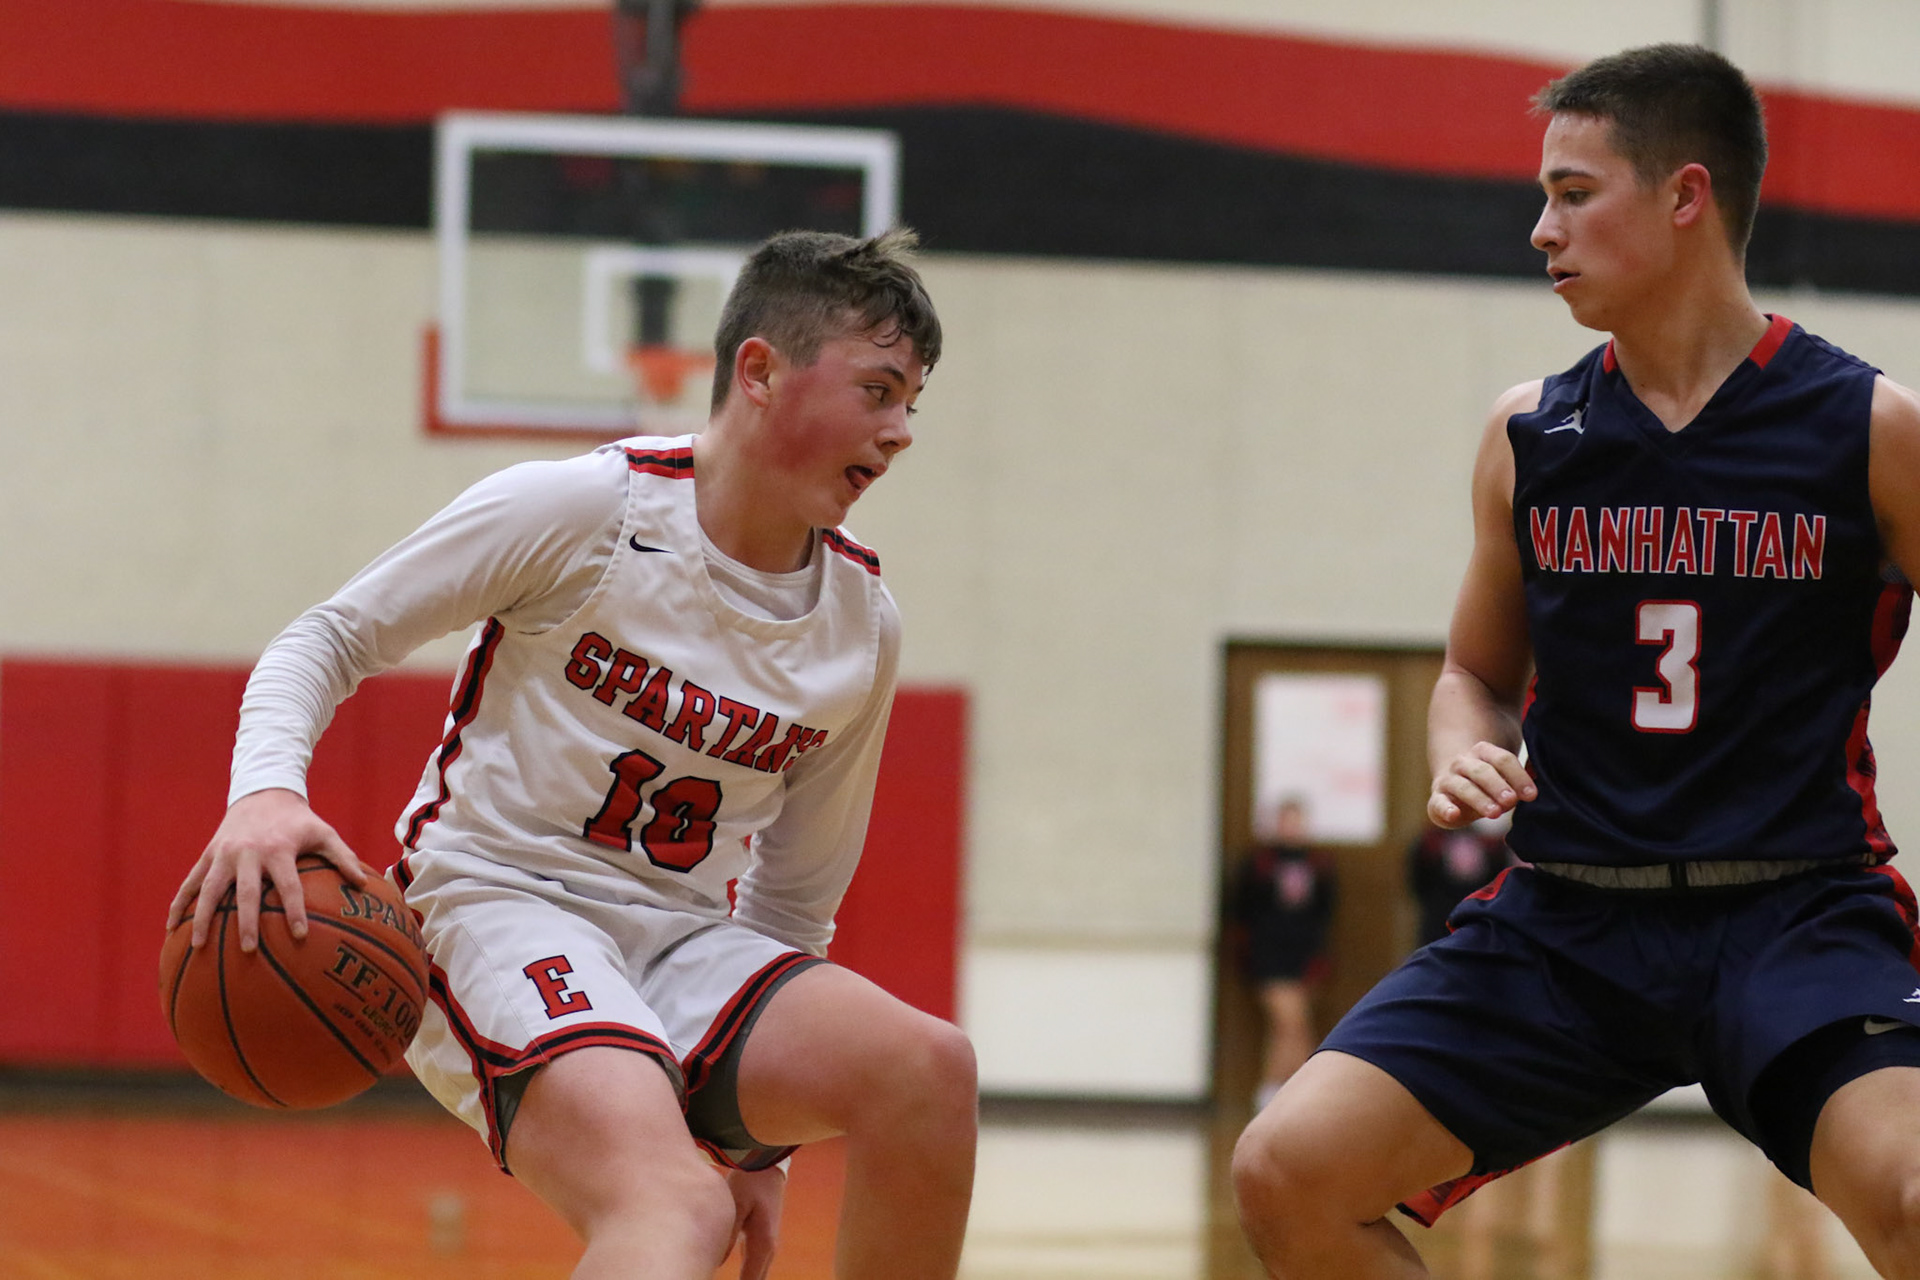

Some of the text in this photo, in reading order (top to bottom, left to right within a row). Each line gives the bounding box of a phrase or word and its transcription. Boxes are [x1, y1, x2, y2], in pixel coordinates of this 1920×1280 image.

[1530, 506, 1827, 580] MANHATTAN
[1631, 599, 1702, 735] 3
[582, 748, 723, 874] 10
[522, 954, 594, 1020] E
